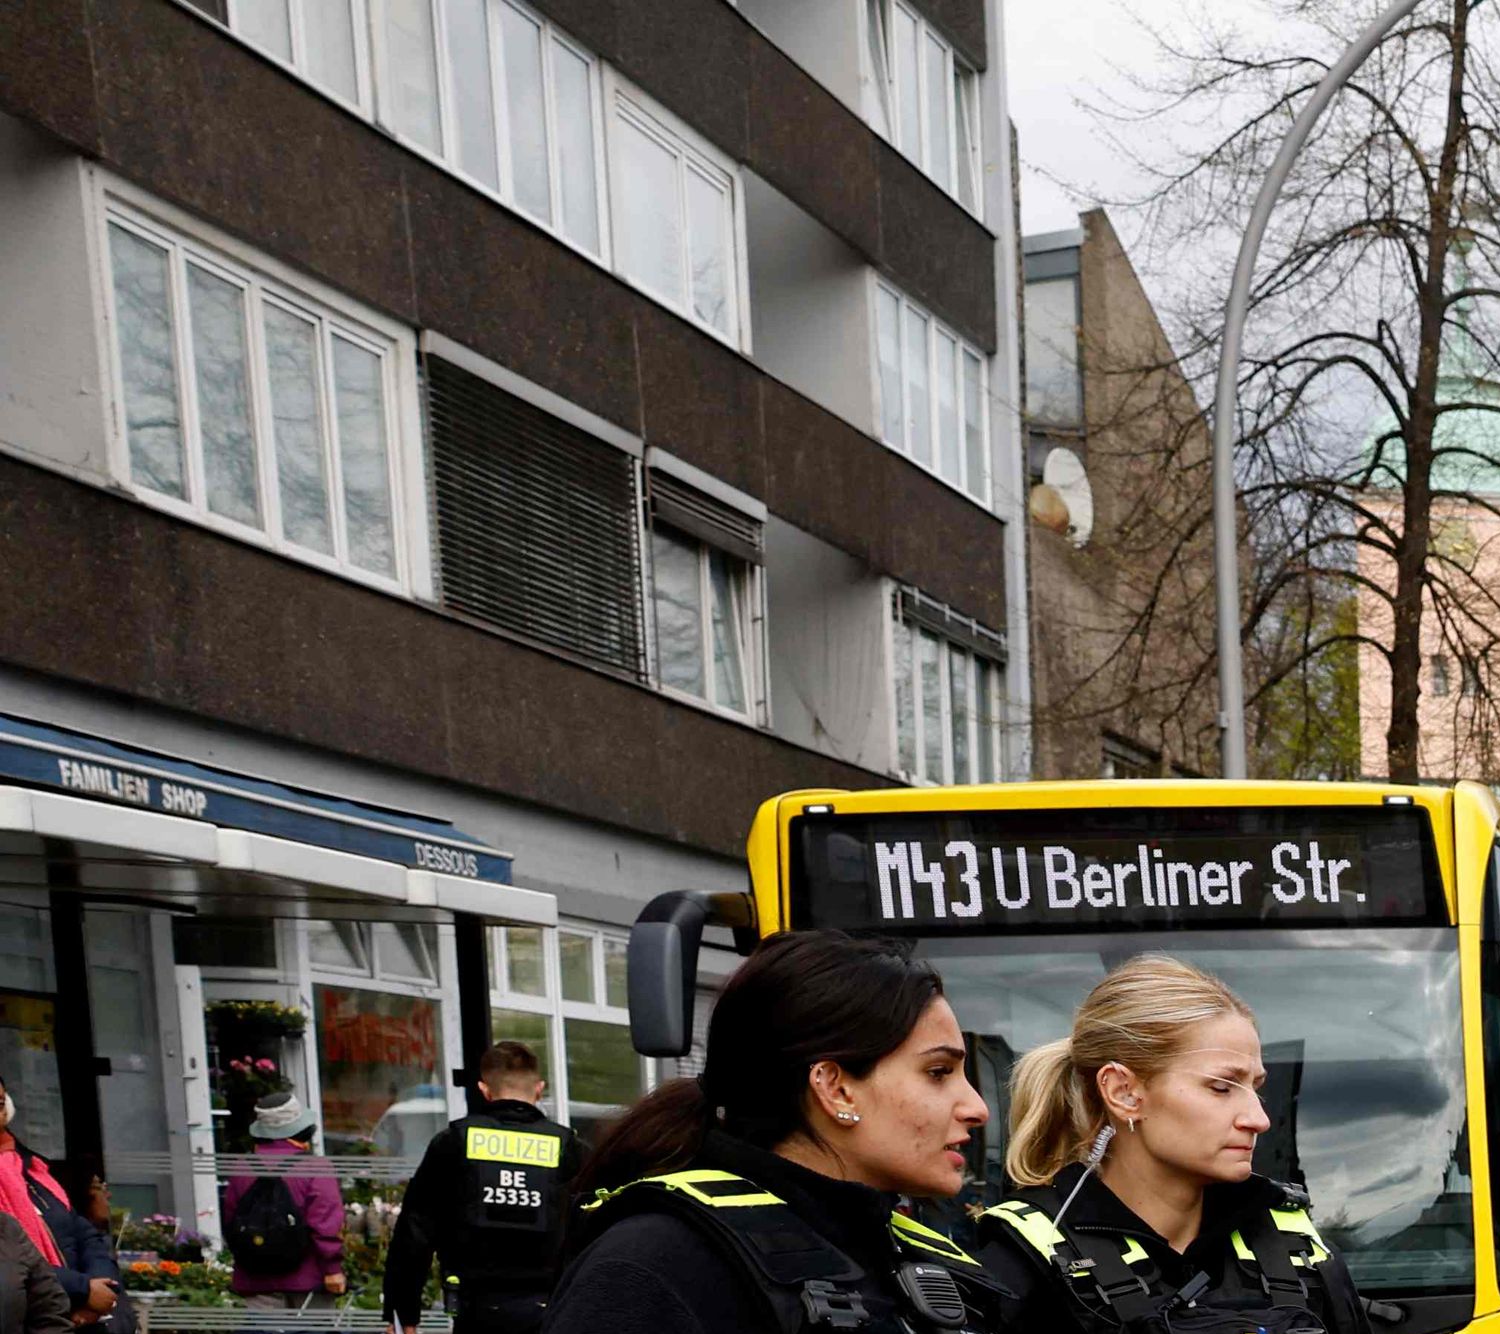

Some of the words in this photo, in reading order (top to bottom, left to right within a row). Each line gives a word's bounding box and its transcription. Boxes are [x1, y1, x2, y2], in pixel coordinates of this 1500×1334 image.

[57, 758, 150, 804] FAMILIEN
[161, 781, 208, 817] SHOP
[414, 841, 479, 878] DESSOUS
[874, 840, 984, 919] M43
[991, 846, 1030, 909] U
[1042, 843, 1254, 910] Berliner
[1270, 840, 1366, 904] Str.
[471, 1132, 555, 1163] POLIZEI
[499, 1169, 527, 1188] BE
[482, 1186, 542, 1208] 25333
